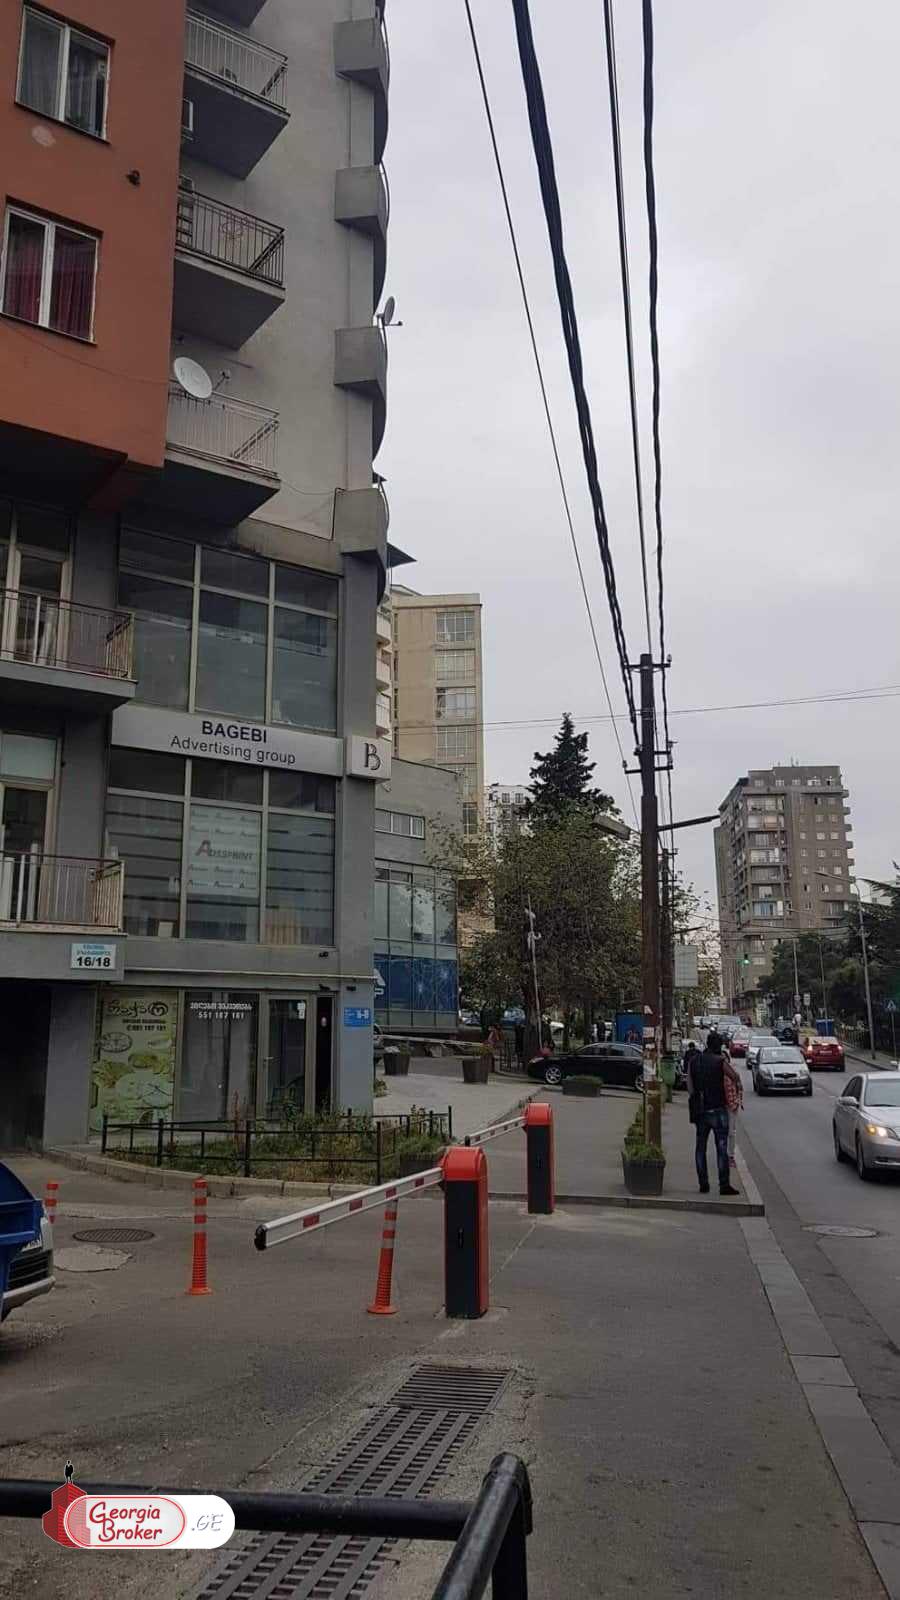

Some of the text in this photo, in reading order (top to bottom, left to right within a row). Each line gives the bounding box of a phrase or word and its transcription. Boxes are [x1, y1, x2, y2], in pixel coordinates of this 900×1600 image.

[202, 720, 267, 743] BAGEBI
[171, 735, 296, 765] Advertising group
[77, 956, 111, 967] 16/18
